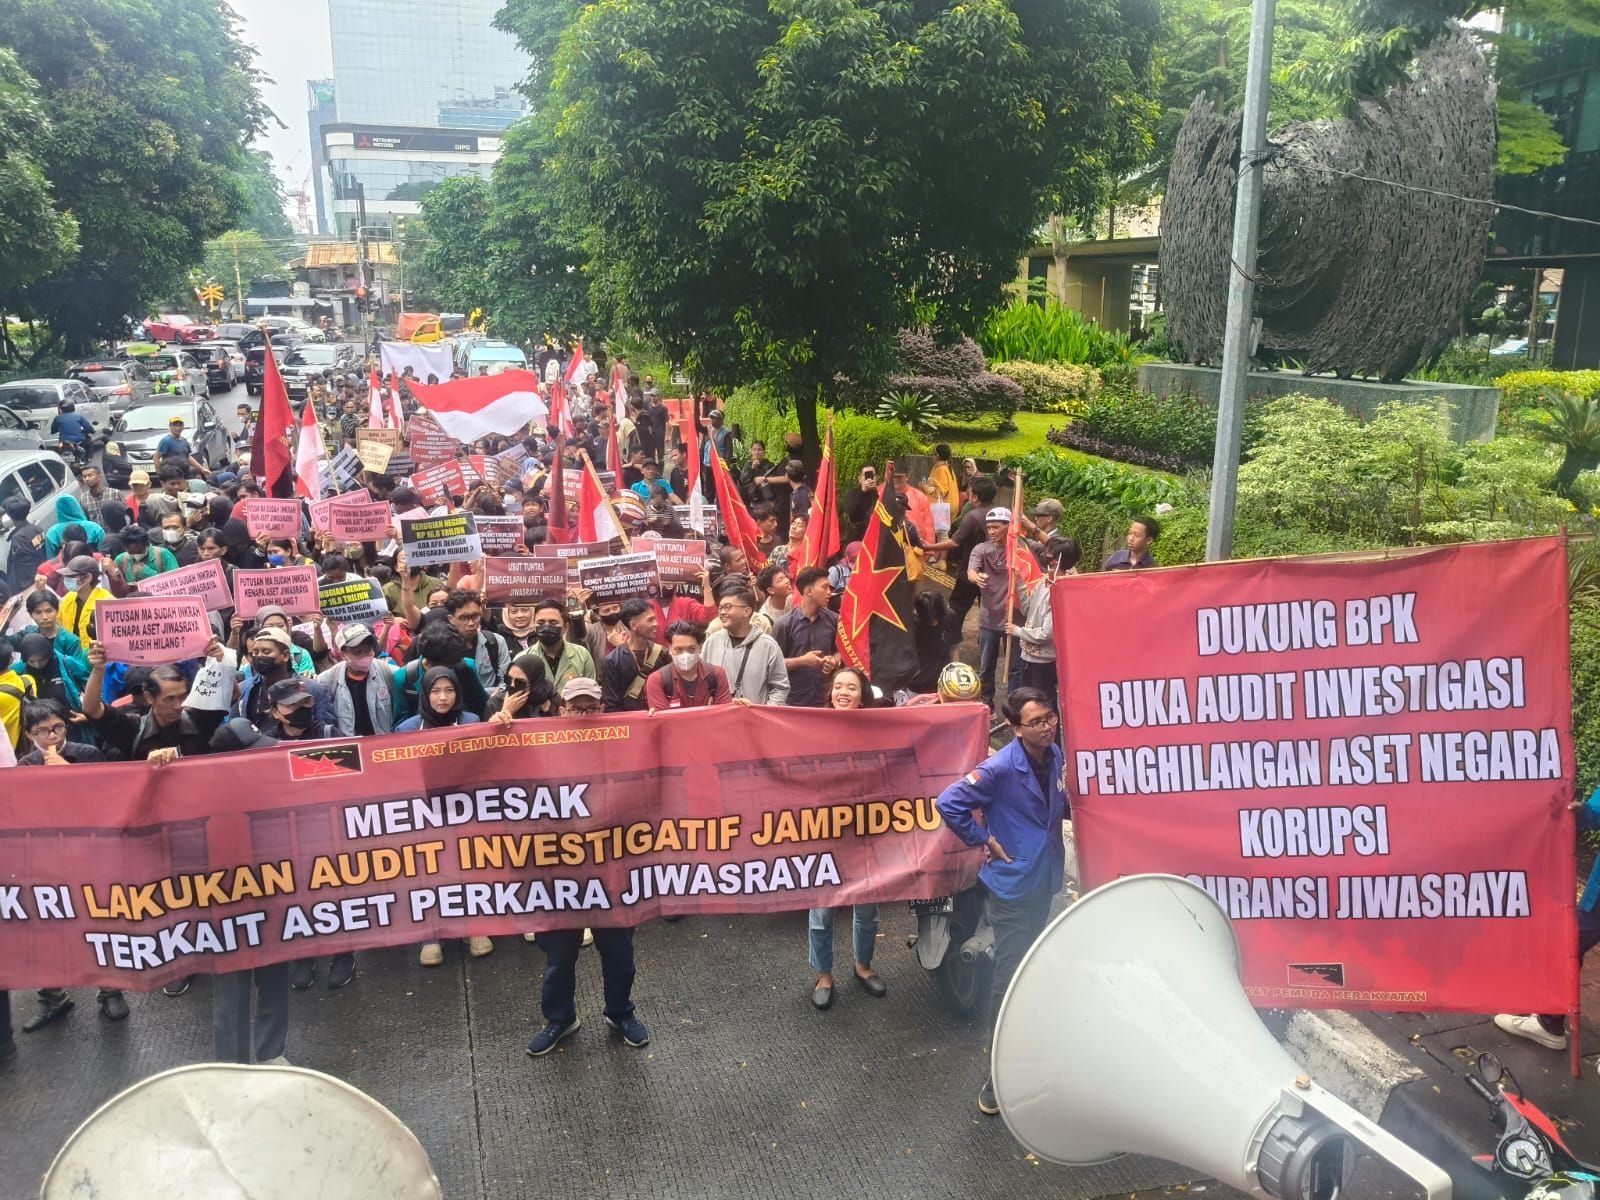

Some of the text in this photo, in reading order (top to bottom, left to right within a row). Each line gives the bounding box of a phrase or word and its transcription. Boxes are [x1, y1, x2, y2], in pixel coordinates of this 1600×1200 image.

[444, 538, 467, 547] DENGAN
[411, 549, 447, 558] PENEGAKAN
[447, 546, 469, 555] HUKUM
[507, 562, 545, 571] USUT TUNTAS
[179, 575, 196, 586] SUDAH
[196, 567, 218, 580] INKRAH
[240, 573, 312, 587] PUTUSAN MA SUDAH INKRAH
[488, 575, 564, 584] PENGGELAPAN ASET NEGARA
[187, 580, 218, 596] JIWASRAYA
[244, 585, 309, 598] KENAPA ASET JIWASRAYA
[509, 588, 538, 597] JIWASRAYA
[274, 597, 294, 607] HILANG
[335, 606, 347, 615] APA
[347, 604, 371, 613] DENGAN
[105, 606, 201, 623] PUTUSAN MA SUDAH INKRAH
[352, 610, 374, 620] HUKUM
[111, 620, 201, 638] KENAPA ASET JIWASRAYA
[1197, 592, 1419, 656] DUKUNG BPK
[129, 636, 186, 652] MASIH HILANG ?
[1099, 656, 1525, 729] BUKA AUDIT INVESTIGASI
[371, 725, 630, 764] SERIKAT PEMUDA KERAKYATAN
[1076, 728, 1563, 796] PENGHILANGAN ASET NEGARA
[344, 783, 591, 840] MENDESAK
[1238, 805, 1390, 858] KORUPSI
[33, 885, 76, 920] RI
[82, 860, 296, 921] LAKUKAN
[309, 840, 445, 890] AUDIT
[458, 814, 741, 871] INVESTIGATIF
[751, 797, 943, 847] JAMPIDSU
[1336, 870, 1531, 921] JIWASRAYA
[85, 852, 843, 970] TERKAIT ASET PERKARA JIWASRAYA
[1272, 987, 1329, 999] PEMUDA
[1333, 990, 1427, 1002] KERAKYATAN
